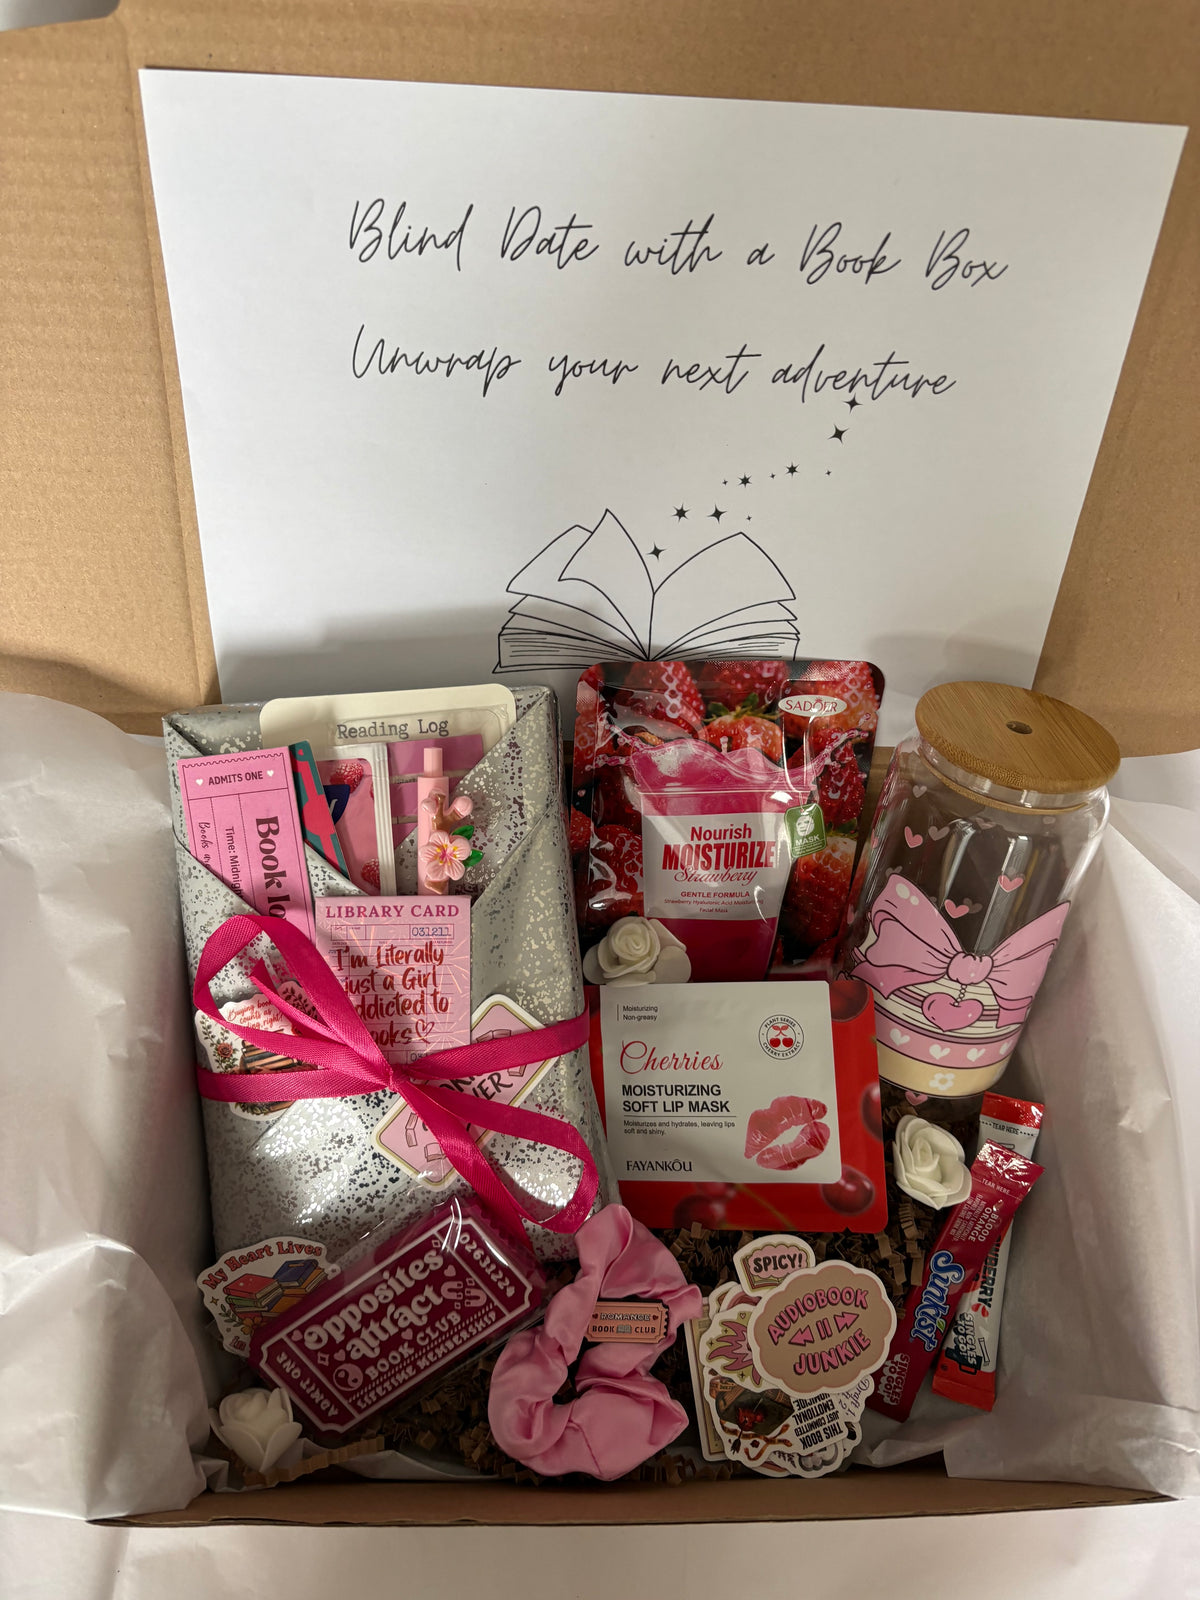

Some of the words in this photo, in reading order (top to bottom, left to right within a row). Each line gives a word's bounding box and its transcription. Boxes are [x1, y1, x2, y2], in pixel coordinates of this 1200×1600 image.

[349, 198, 474, 272] Blind
[500, 206, 599, 270] Date
[624, 214, 723, 275] with
[747, 246, 775, 265] a
[800, 223, 902, 285] Book
[925, 228, 1008, 290] Box
[352, 324, 522, 397] Unwrap
[548, 356, 639, 397] your
[662, 344, 762, 393] next
[772, 344, 957, 403] adventure
[336, 722, 409, 740] Reading
[418, 718, 450, 737] Log
[208, 772, 243, 786] ADMITS
[244, 771, 264, 781] ONE
[198, 821, 214, 849] Books
[225, 826, 236, 854] Time:
[690, 823, 752, 841] Nourish
[795, 834, 820, 846] MASK
[256, 815, 287, 890] Book
[661, 840, 777, 871] MOISTURIZE
[229, 855, 245, 899] Midnigh
[673, 865, 759, 886] Strawberry
[325, 905, 404, 918] LIBRARY
[410, 904, 460, 918] CARD
[411, 926, 452, 937] 031211
[335, 945, 369, 971] I'm
[376, 941, 444, 969] Literally
[383, 975, 396, 990] a
[402, 965, 438, 992] Girl
[354, 990, 426, 1021] ddicted
[432, 986, 449, 1013] to
[622, 1004, 659, 1013] Moisturizing
[622, 1013, 658, 1021] Non-greasy
[372, 1020, 413, 1047] ooks
[620, 1039, 724, 1074] Cherries
[621, 1084, 722, 1097] MOISTURIZING
[622, 1100, 659, 1113] SOFT
[662, 1100, 684, 1113] LIP
[688, 1100, 730, 1113] MASK
[670, 1120, 700, 1128] hydrates,
[700, 1120, 723, 1128] leaving
[992, 1122, 1006, 1132] TEAR
[1005, 1126, 1020, 1135] HERE
[982, 1178, 996, 1189] TEAR
[968, 1207, 993, 1242] ORANGE
[977, 1212, 999, 1242] BLOOD
[202, 1267, 229, 1290] My
[224, 1244, 274, 1272] Heart
[276, 1241, 323, 1257] Lives
[753, 1253, 803, 1274] SPICY!
[303, 1249, 445, 1350] Opposites
[912, 1250, 965, 1352] Sunkist
[345, 1283, 443, 1361] attract
[600, 1313, 651, 1321] ROMANCE
[767, 1287, 869, 1346] AUDIOBOOK
[365, 1341, 415, 1381] BOOK
[416, 1310, 462, 1346] CLUB
[793, 1328, 872, 1376] JUNKIE
[964, 1312, 978, 1365] SINGLES
[276, 1351, 302, 1379] ONE
[356, 1365, 417, 1410] LIFETIME
[416, 1310, 497, 1370] MEMBERSHIP
[890, 1353, 911, 1405] SINGLES
[300, 1378, 339, 1417] ADMIT
[852, 1378, 870, 1409] Draft
[792, 1399, 836, 1425] EMOTIONAL
[826, 1410, 840, 1423] JUST
[794, 1417, 826, 1437] COMMITTED
[799, 1431, 824, 1450] BOOK
[822, 1422, 843, 1440] THIS
